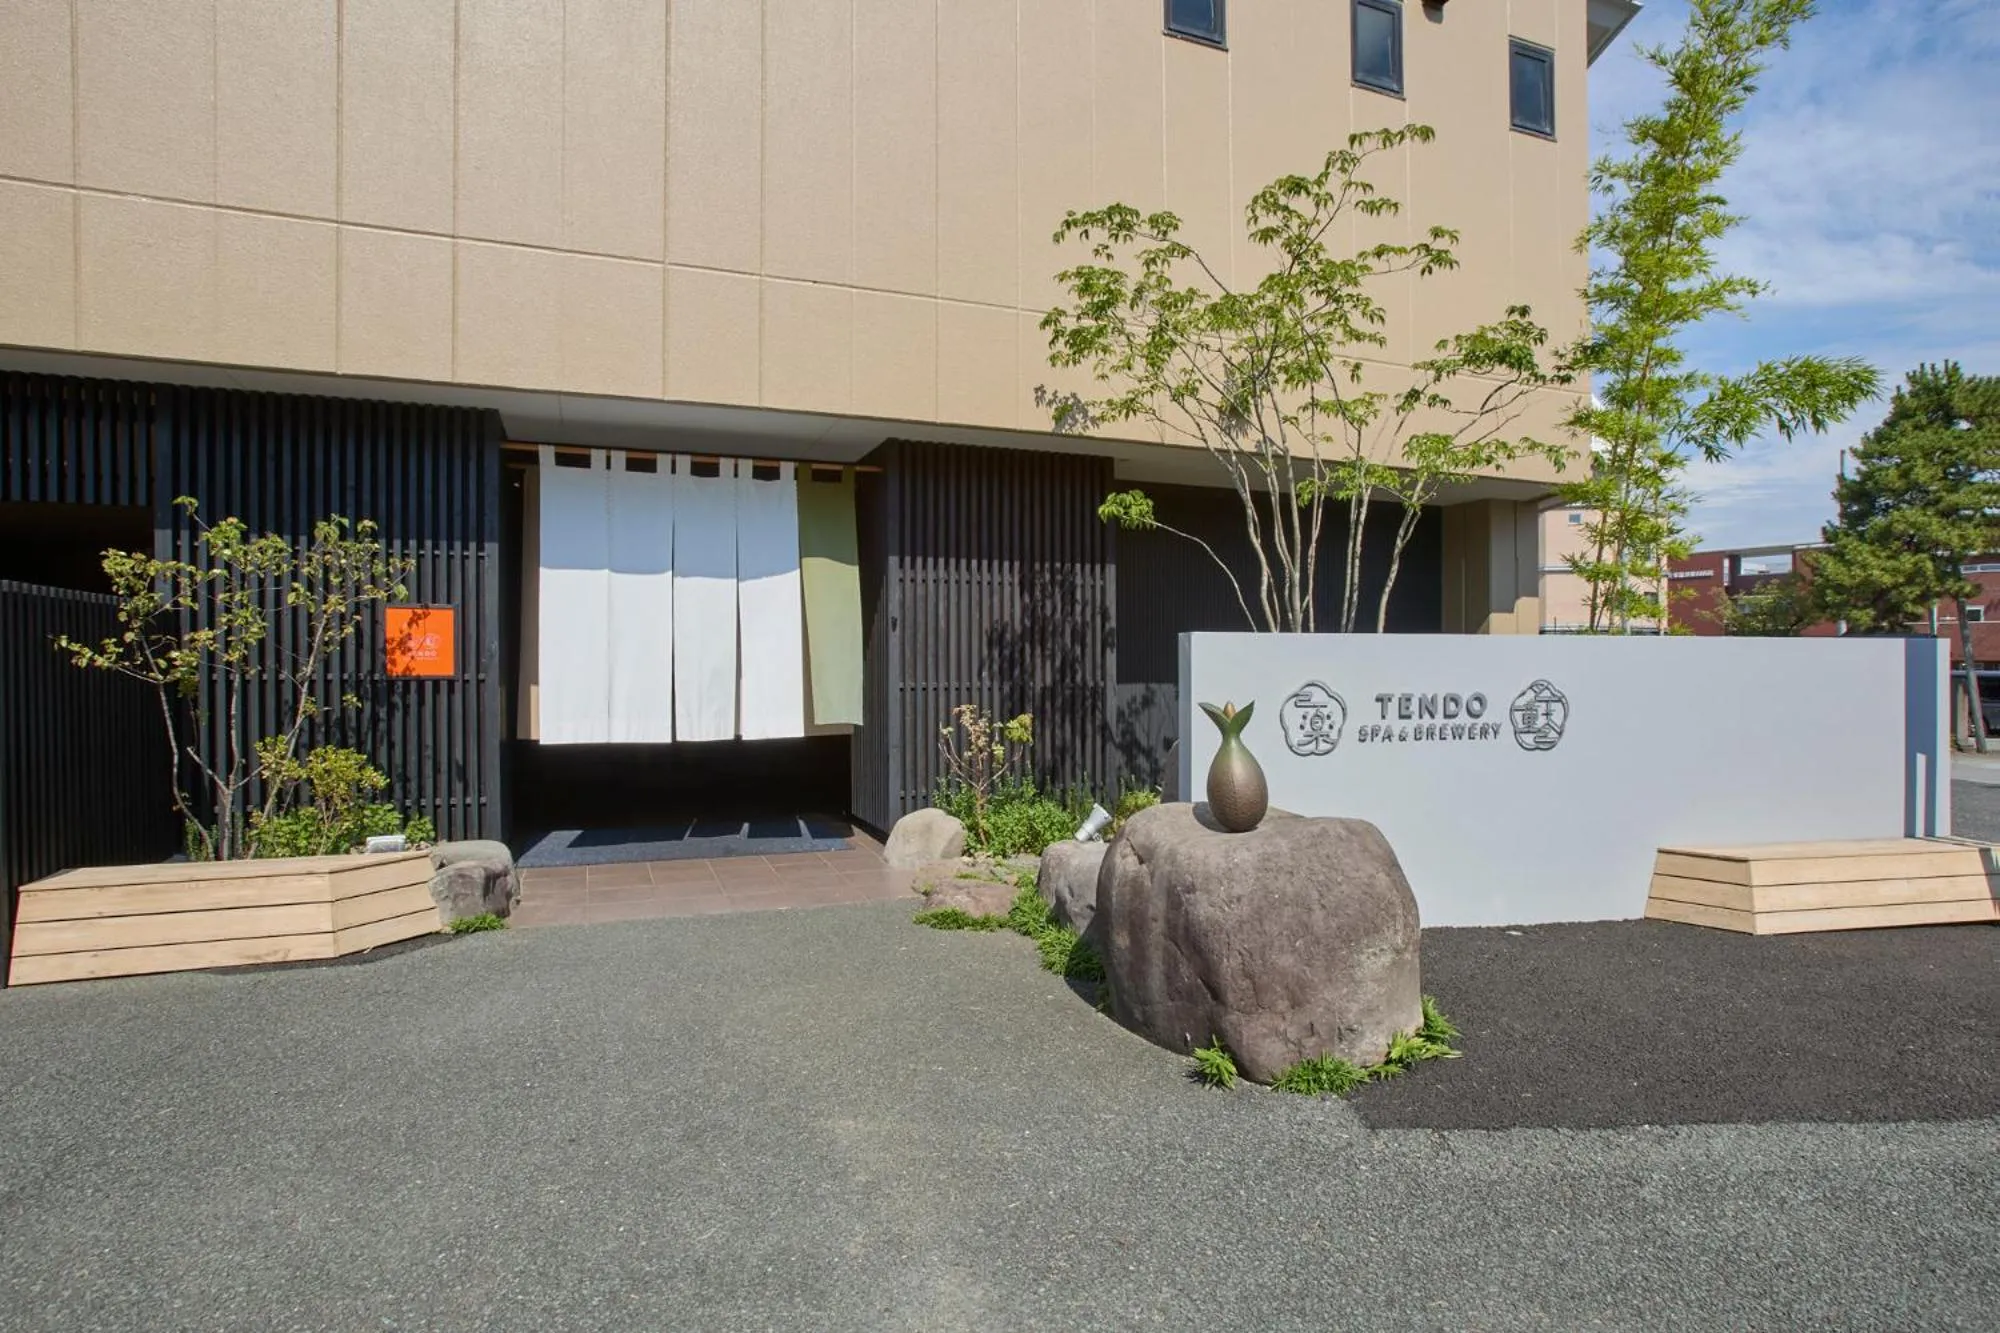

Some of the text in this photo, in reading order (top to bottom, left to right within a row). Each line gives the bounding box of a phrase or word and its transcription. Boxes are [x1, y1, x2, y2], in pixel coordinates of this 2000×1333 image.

[1375, 692, 1488, 720] TENDO
[1358, 722, 1502, 742] SPA & BREWERY
